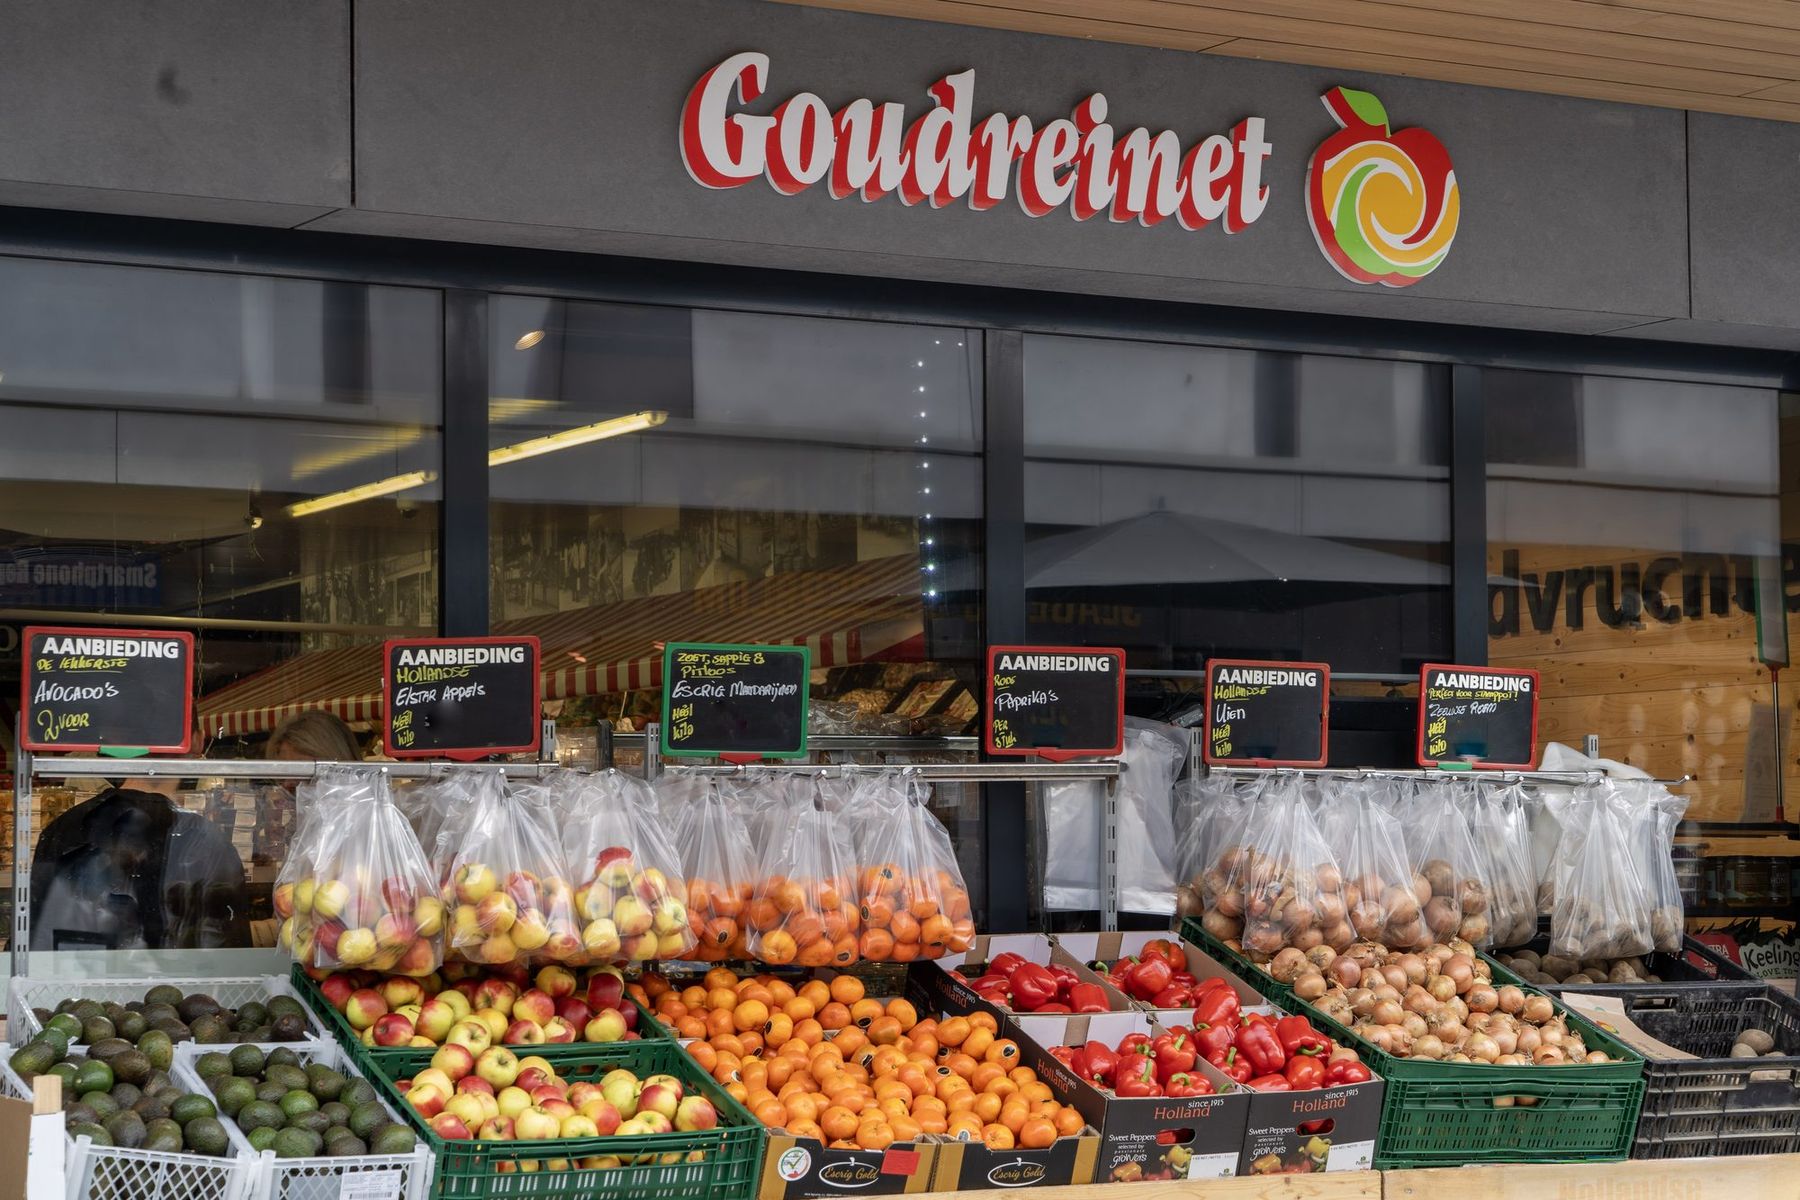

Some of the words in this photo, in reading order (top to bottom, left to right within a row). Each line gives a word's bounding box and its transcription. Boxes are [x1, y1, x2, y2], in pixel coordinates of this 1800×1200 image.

[681, 51, 1273, 234] Goudreinet
[42, 637, 179, 659] AANBIEDING
[398, 647, 524, 666] AANBIEDING
[999, 655, 1110, 672] AANBIEDING
[1218, 669, 1317, 687] AANBIEDING
[1435, 673, 1530, 692] AANBIEDING
[37, 710, 60, 741] 2
[935, 976, 967, 1008] Holland
[1037, 1059, 1068, 1094] Holland
[1324, 1091, 1345, 1100] since
[1345, 1088, 1359, 1097] 1915
[1154, 1104, 1211, 1120] Holland
[1188, 1100, 1209, 1109] since
[1210, 1098, 1225, 1107] 1915
[1293, 1095, 1347, 1112] Holland
[1109, 1134, 1129, 1142] Sweet
[1130, 1132, 1156, 1143] Peppers
[1269, 1126, 1296, 1136] Peppers
[825, 1167, 852, 1181] Escrig
[855, 1168, 880, 1179] Gold
[993, 1168, 1020, 1181] Escrig
[1023, 1166, 1046, 1178] Gold
